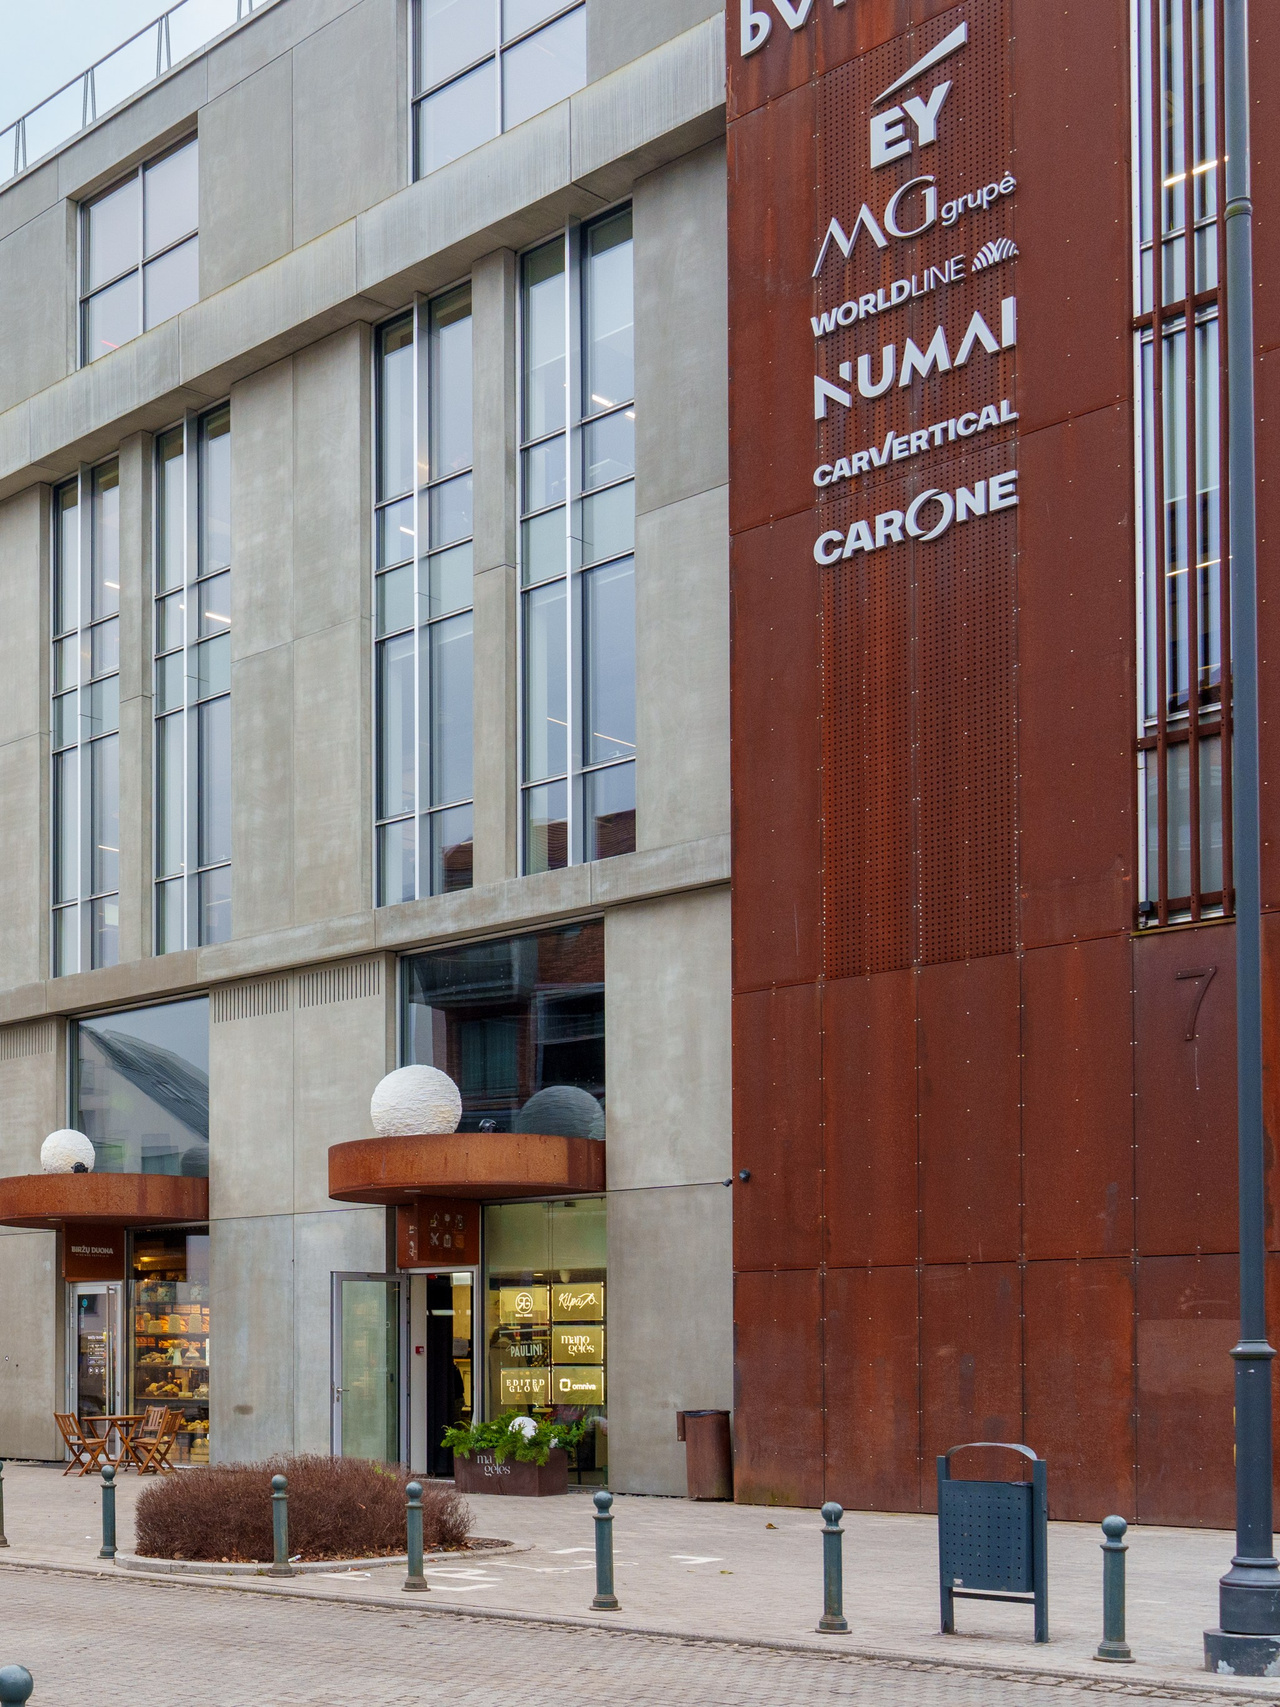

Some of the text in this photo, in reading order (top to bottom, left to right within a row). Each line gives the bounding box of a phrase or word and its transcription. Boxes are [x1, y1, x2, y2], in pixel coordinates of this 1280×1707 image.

[870, 80, 954, 170] EY
[811, 170, 1017, 279] MG grupė
[810, 254, 967, 338] WORLDLINE
[814, 295, 1017, 421] NUMAI
[813, 469, 1019, 567] CARONE
[1175, 965, 1218, 1042] 7
[506, 1379, 545, 1387] EDITED
[509, 1385, 540, 1393] GLOW
[572, 1382, 597, 1391] omniva
